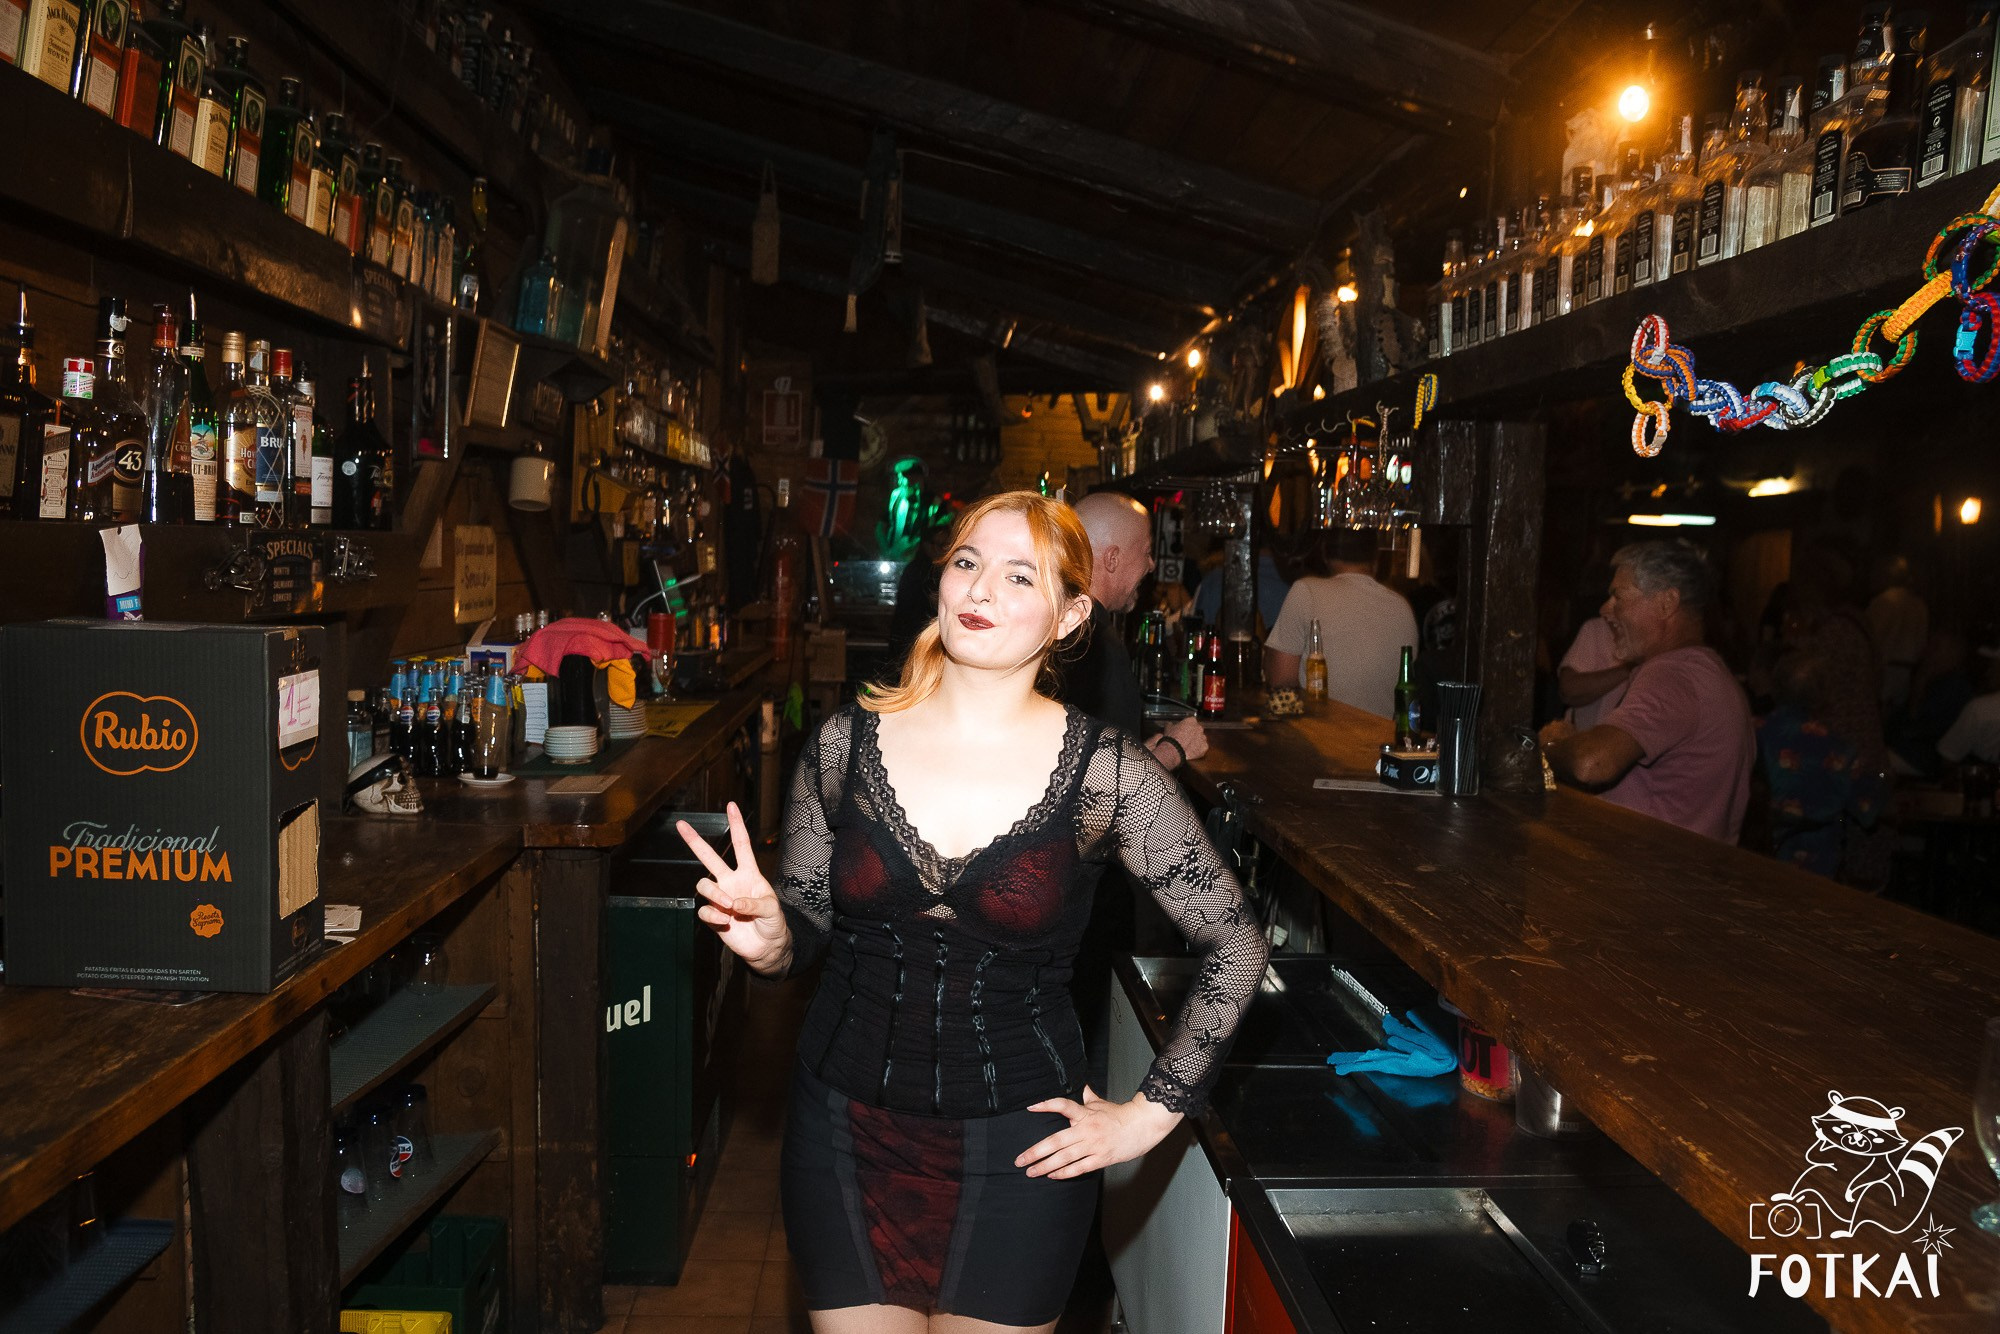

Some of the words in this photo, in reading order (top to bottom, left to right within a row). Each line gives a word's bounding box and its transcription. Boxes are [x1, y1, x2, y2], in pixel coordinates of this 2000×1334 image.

[47, 47, 70, 64] HONEY
[113, 344, 125, 355] 43
[118, 450, 143, 472] 43
[266, 539, 314, 560] SPECIALS
[94, 711, 188, 751] Rubio
[63, 820, 219, 853] Tradicional
[49, 846, 232, 882] PREMIUM
